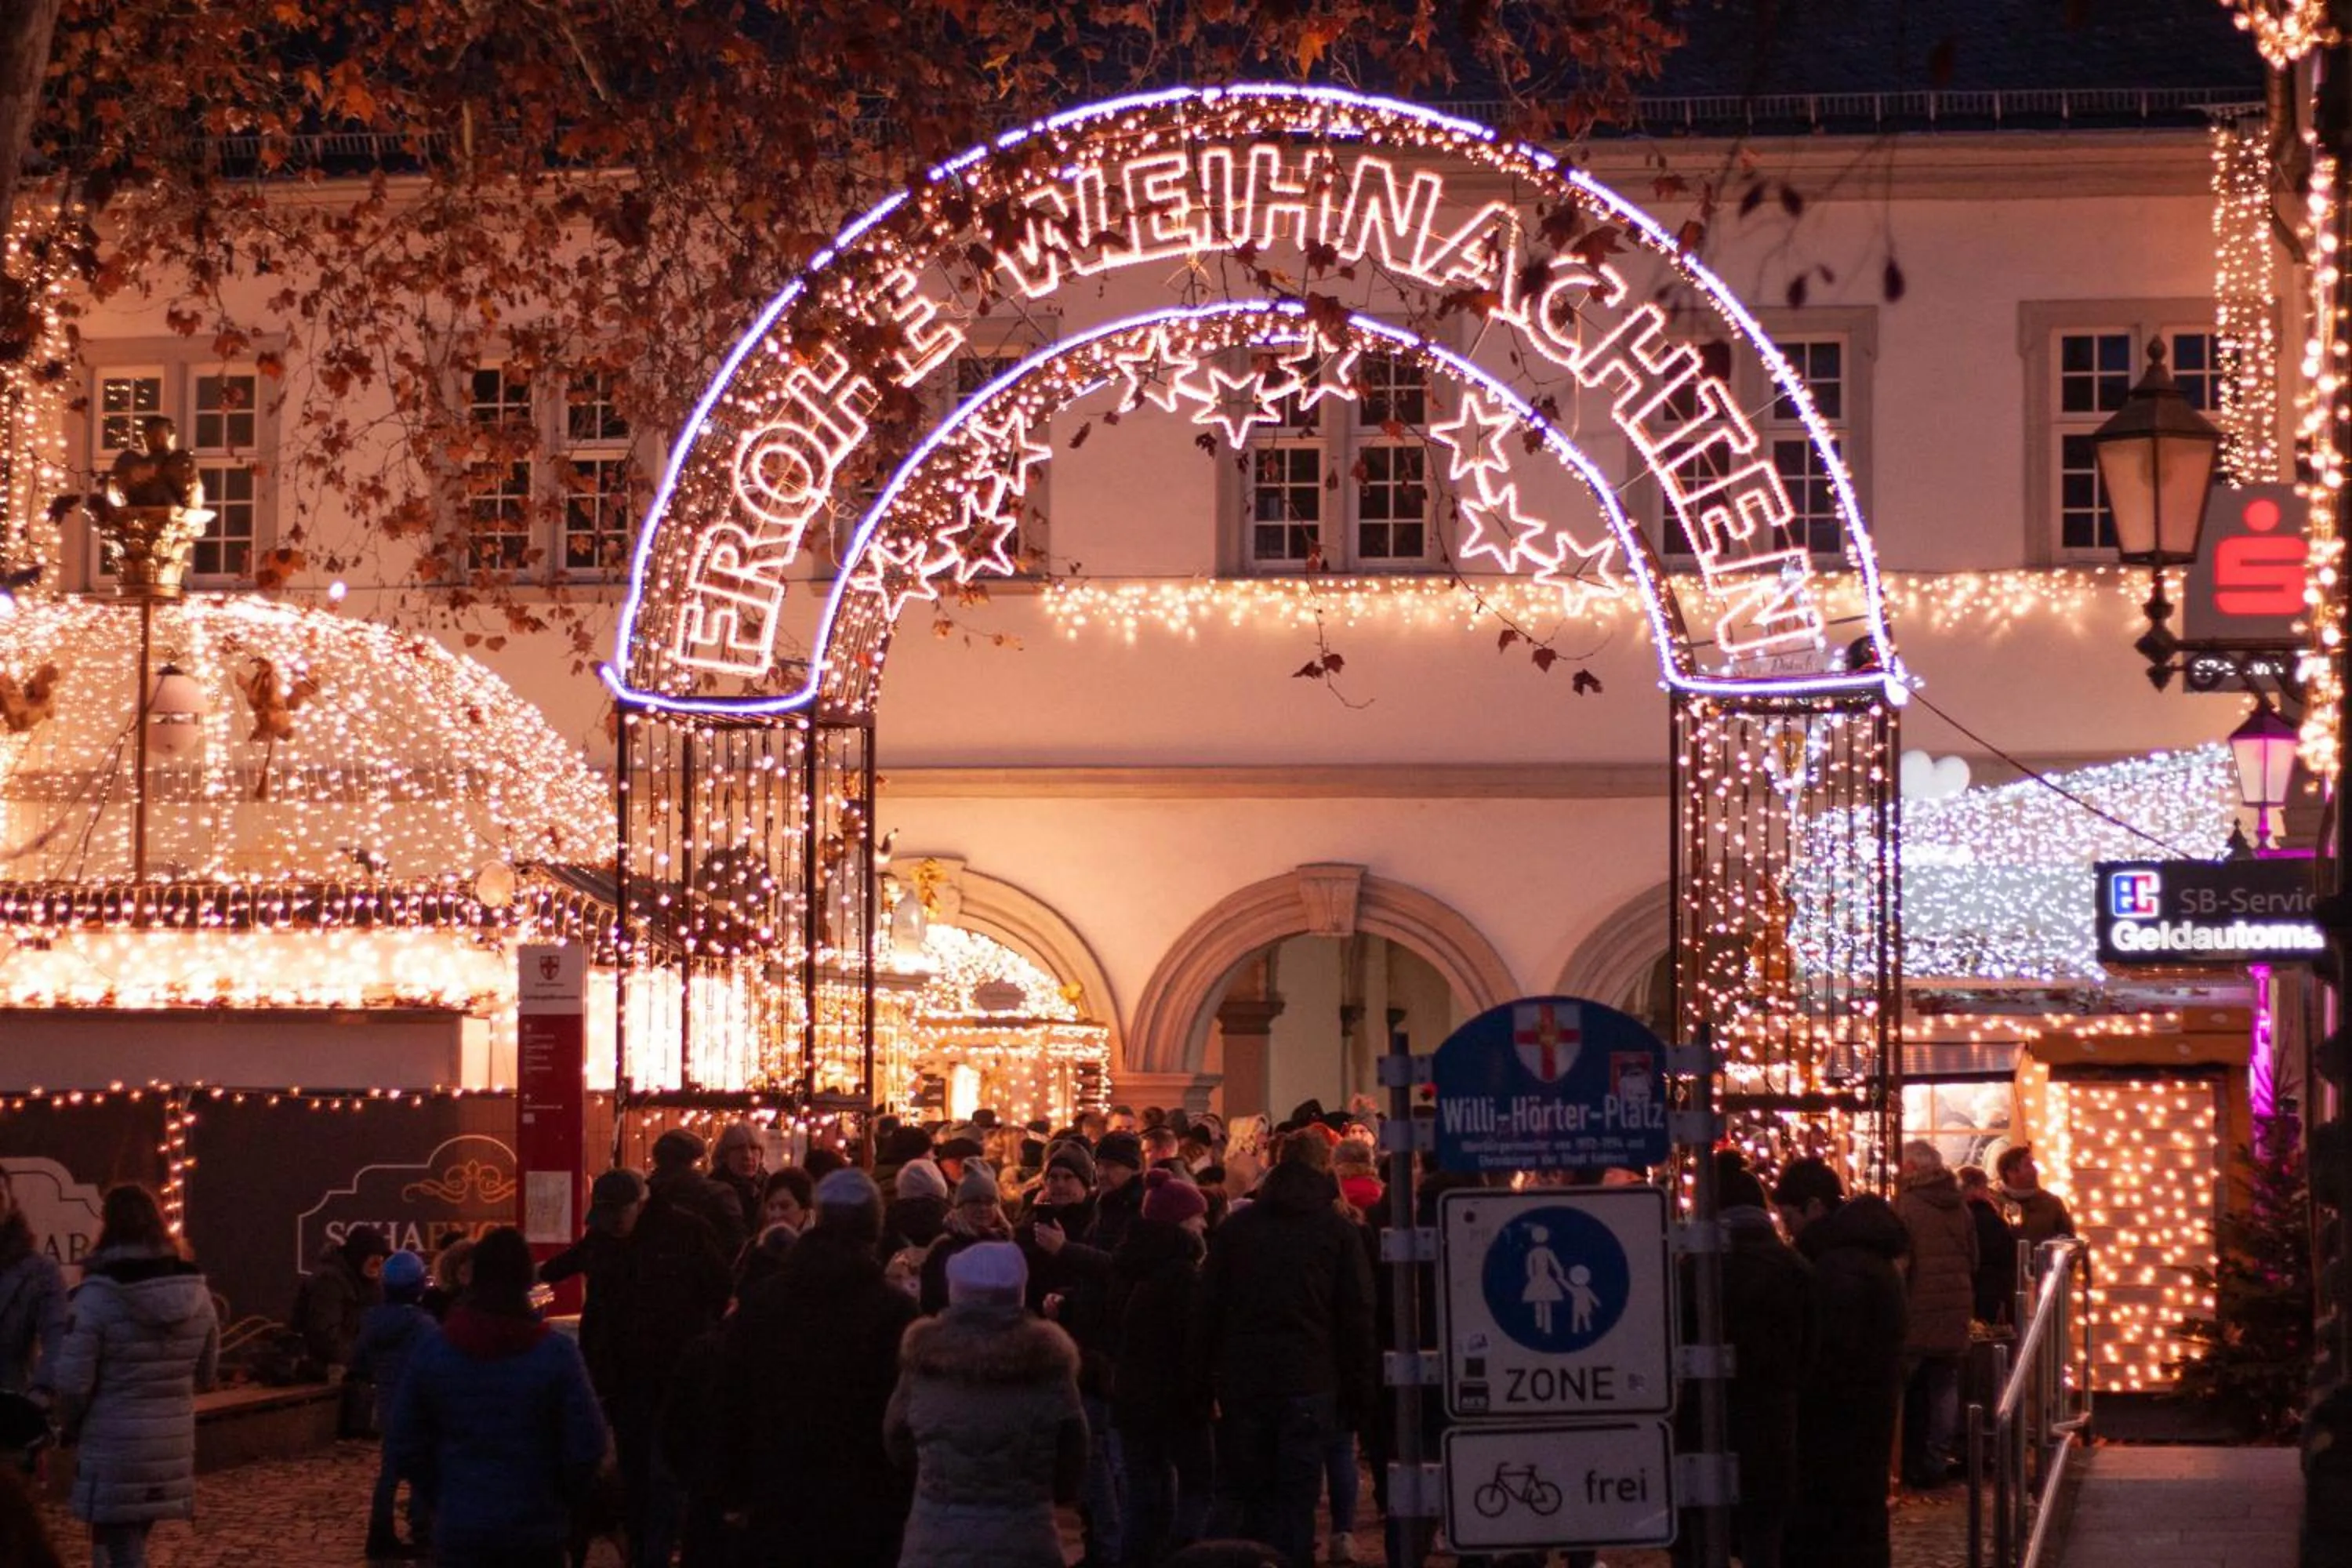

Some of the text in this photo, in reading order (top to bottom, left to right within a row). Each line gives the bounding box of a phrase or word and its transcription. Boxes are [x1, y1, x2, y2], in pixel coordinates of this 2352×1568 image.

[674, 143, 1824, 677] FROHE WEIHNACHTEN
[1441, 1094, 1665, 1134] Willi-Hörter-Platz
[1505, 1366, 1615, 1403] ZONE
[1584, 1468, 1647, 1504] frei
